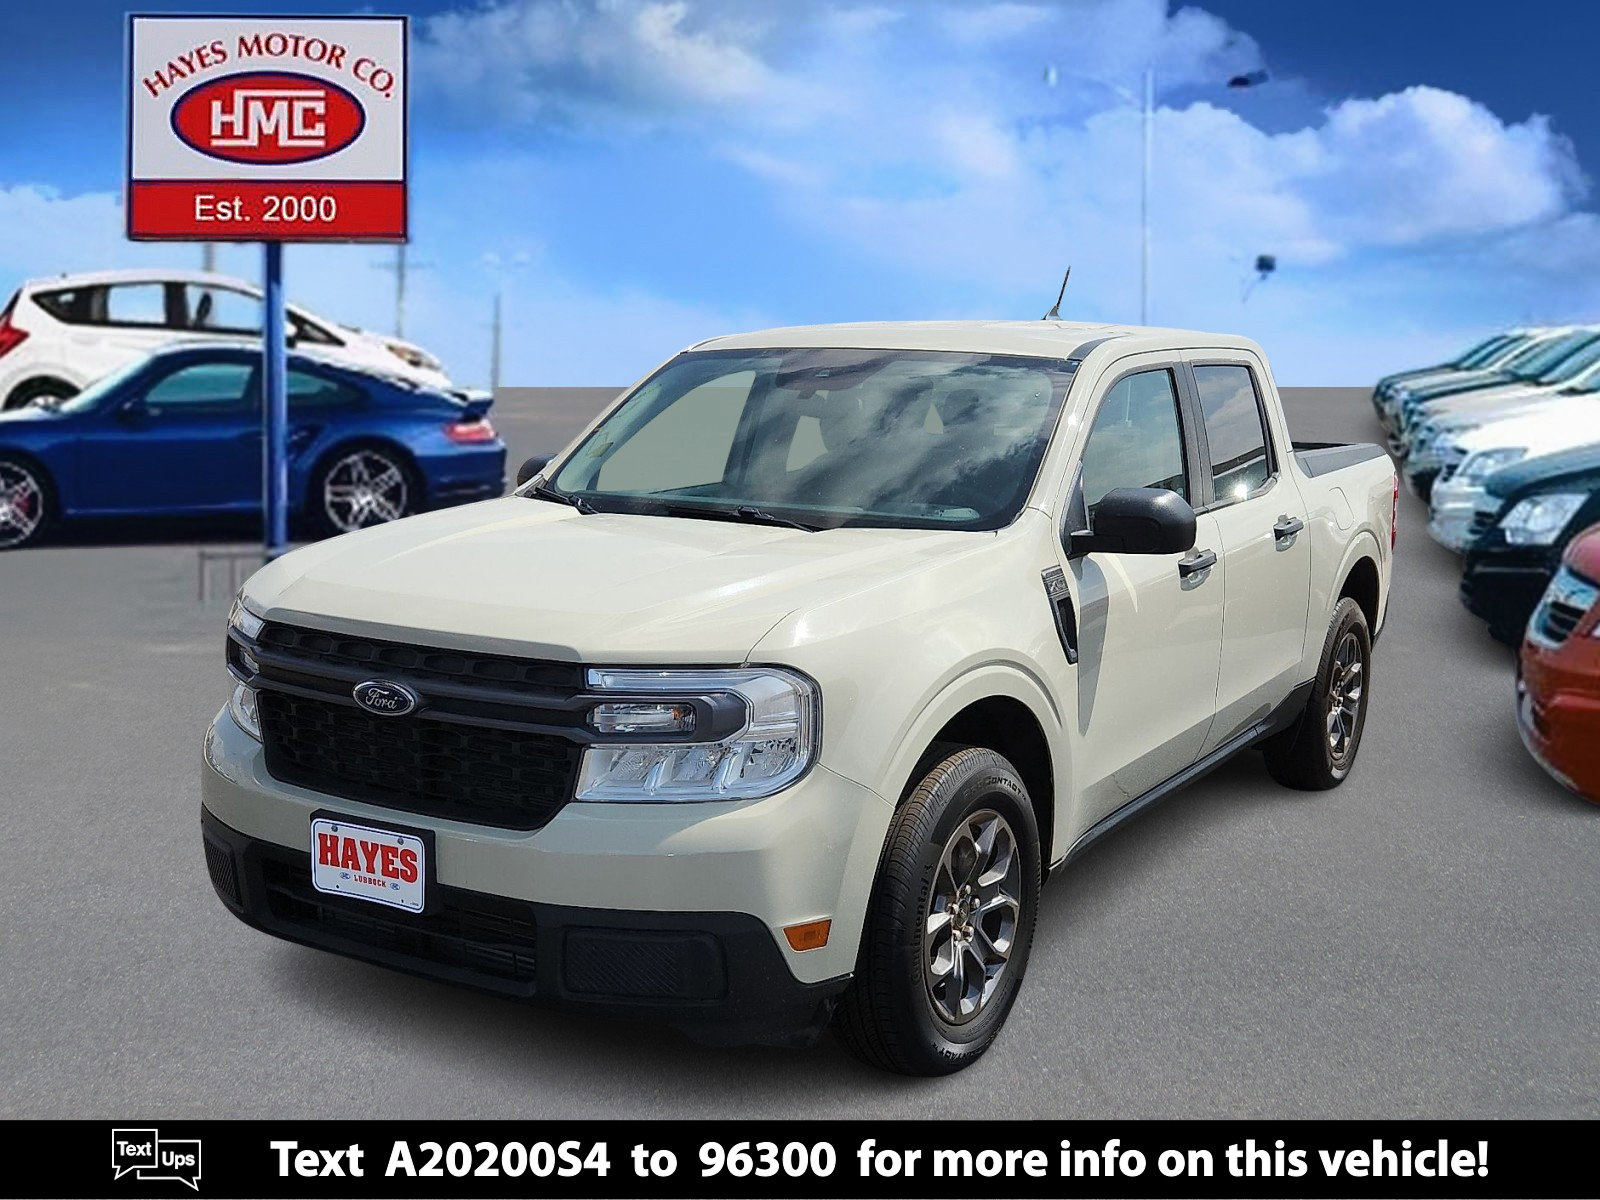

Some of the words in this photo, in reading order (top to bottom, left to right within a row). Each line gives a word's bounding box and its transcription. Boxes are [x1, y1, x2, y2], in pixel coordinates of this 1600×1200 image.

[142, 40, 228, 98] HAYES
[237, 32, 347, 70] MOTOR
[352, 57, 395, 99] CO.
[210, 88, 326, 148] HMC
[194, 194, 251, 222] Est.
[261, 194, 337, 223] 2000
[365, 687, 399, 710] Ford
[318, 832, 418, 884] HAYES
[353, 874, 387, 888] LUBBOCK
